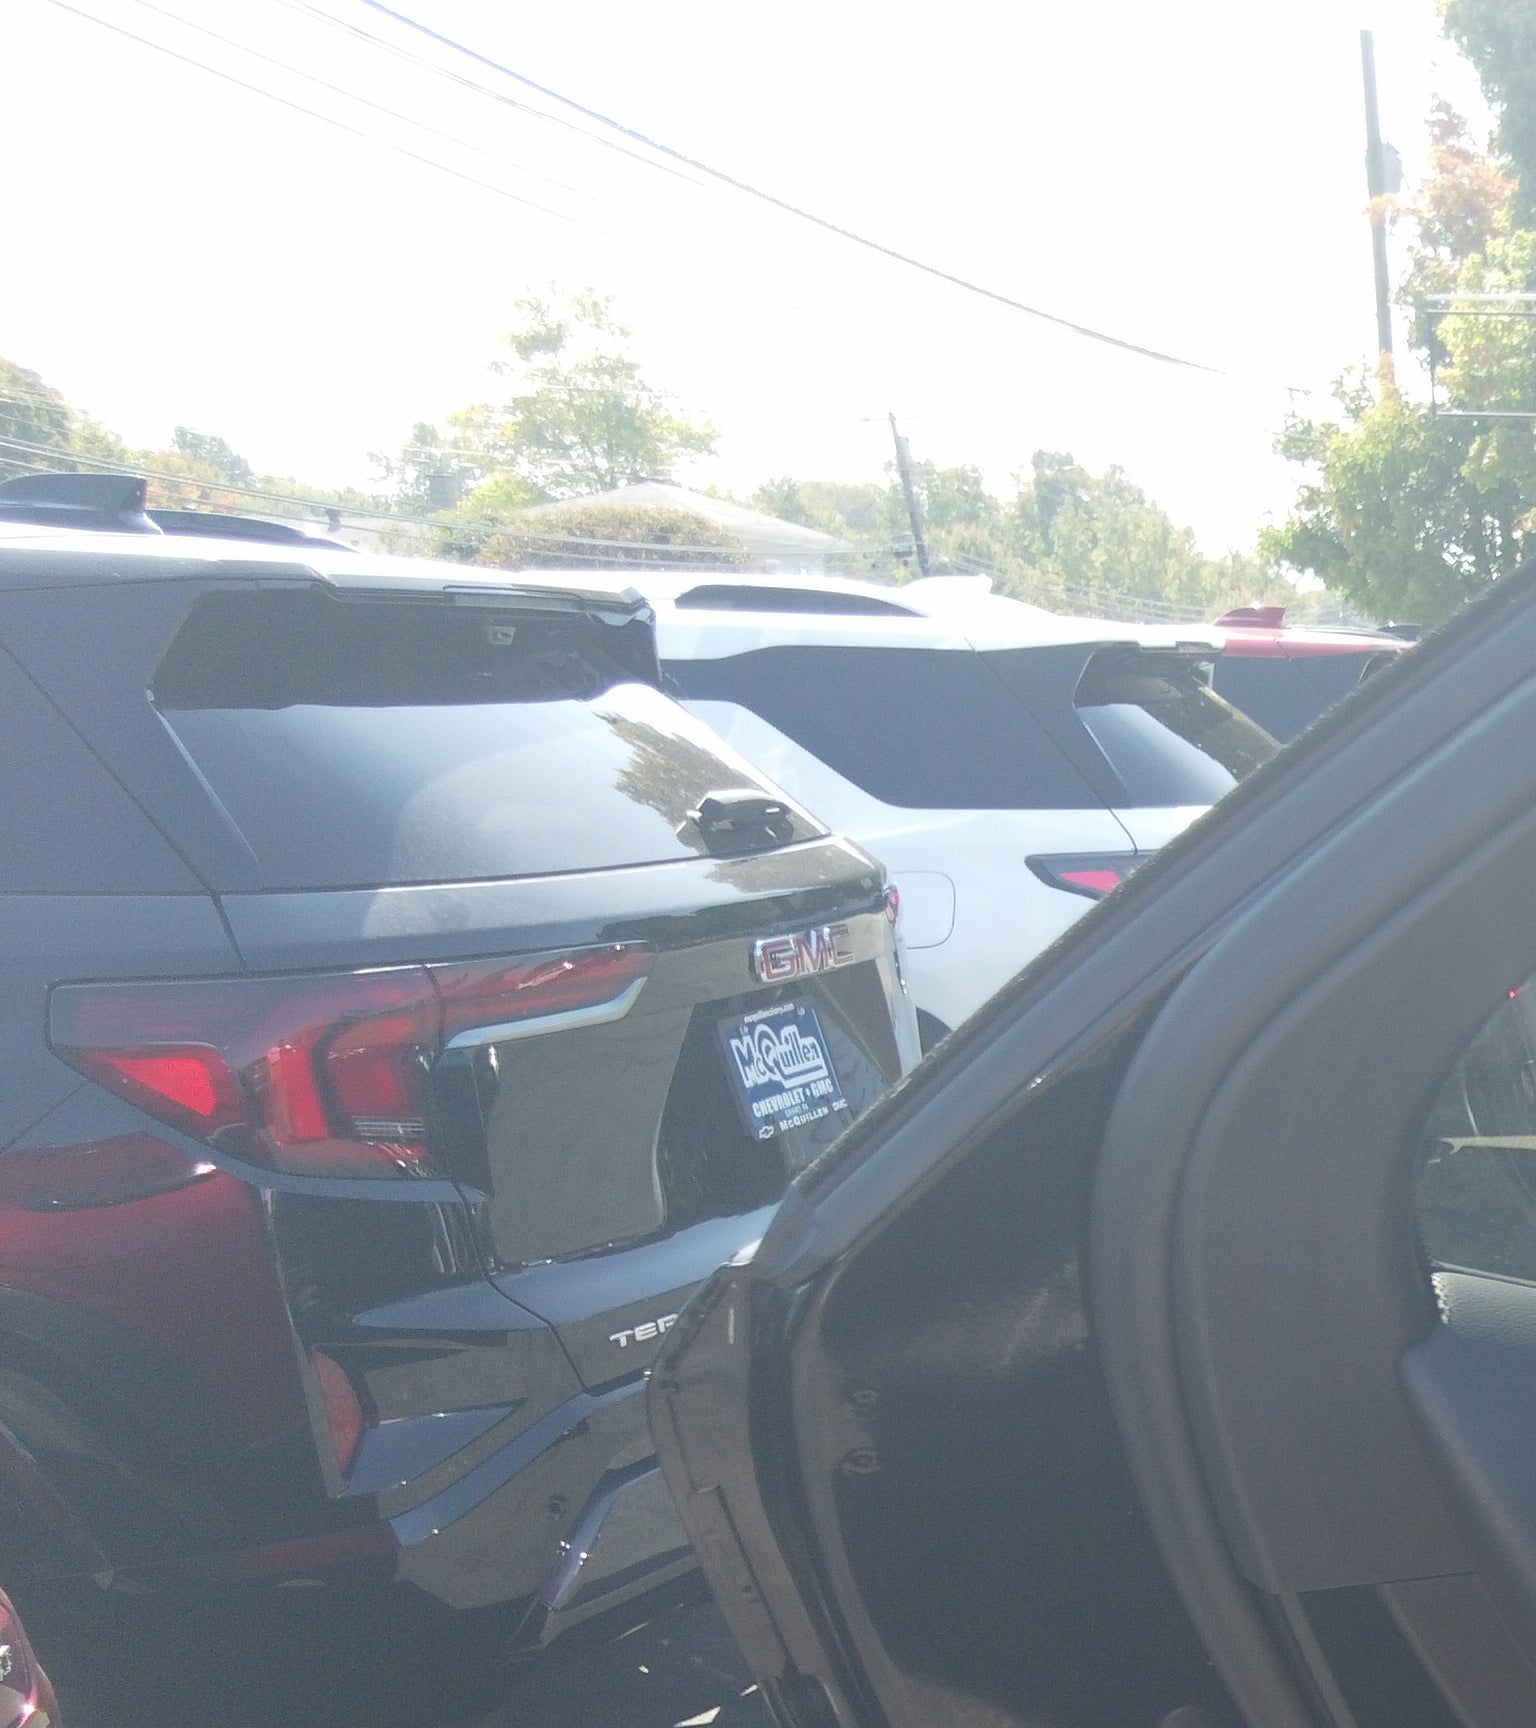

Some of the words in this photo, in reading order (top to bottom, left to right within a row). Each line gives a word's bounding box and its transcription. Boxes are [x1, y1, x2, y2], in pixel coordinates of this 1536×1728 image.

[755, 924, 855, 982] GMC
[729, 1024, 829, 1088] McQuillen
[752, 1087, 805, 1118] CHEVROLET
[810, 1078, 834, 1098] GMC
